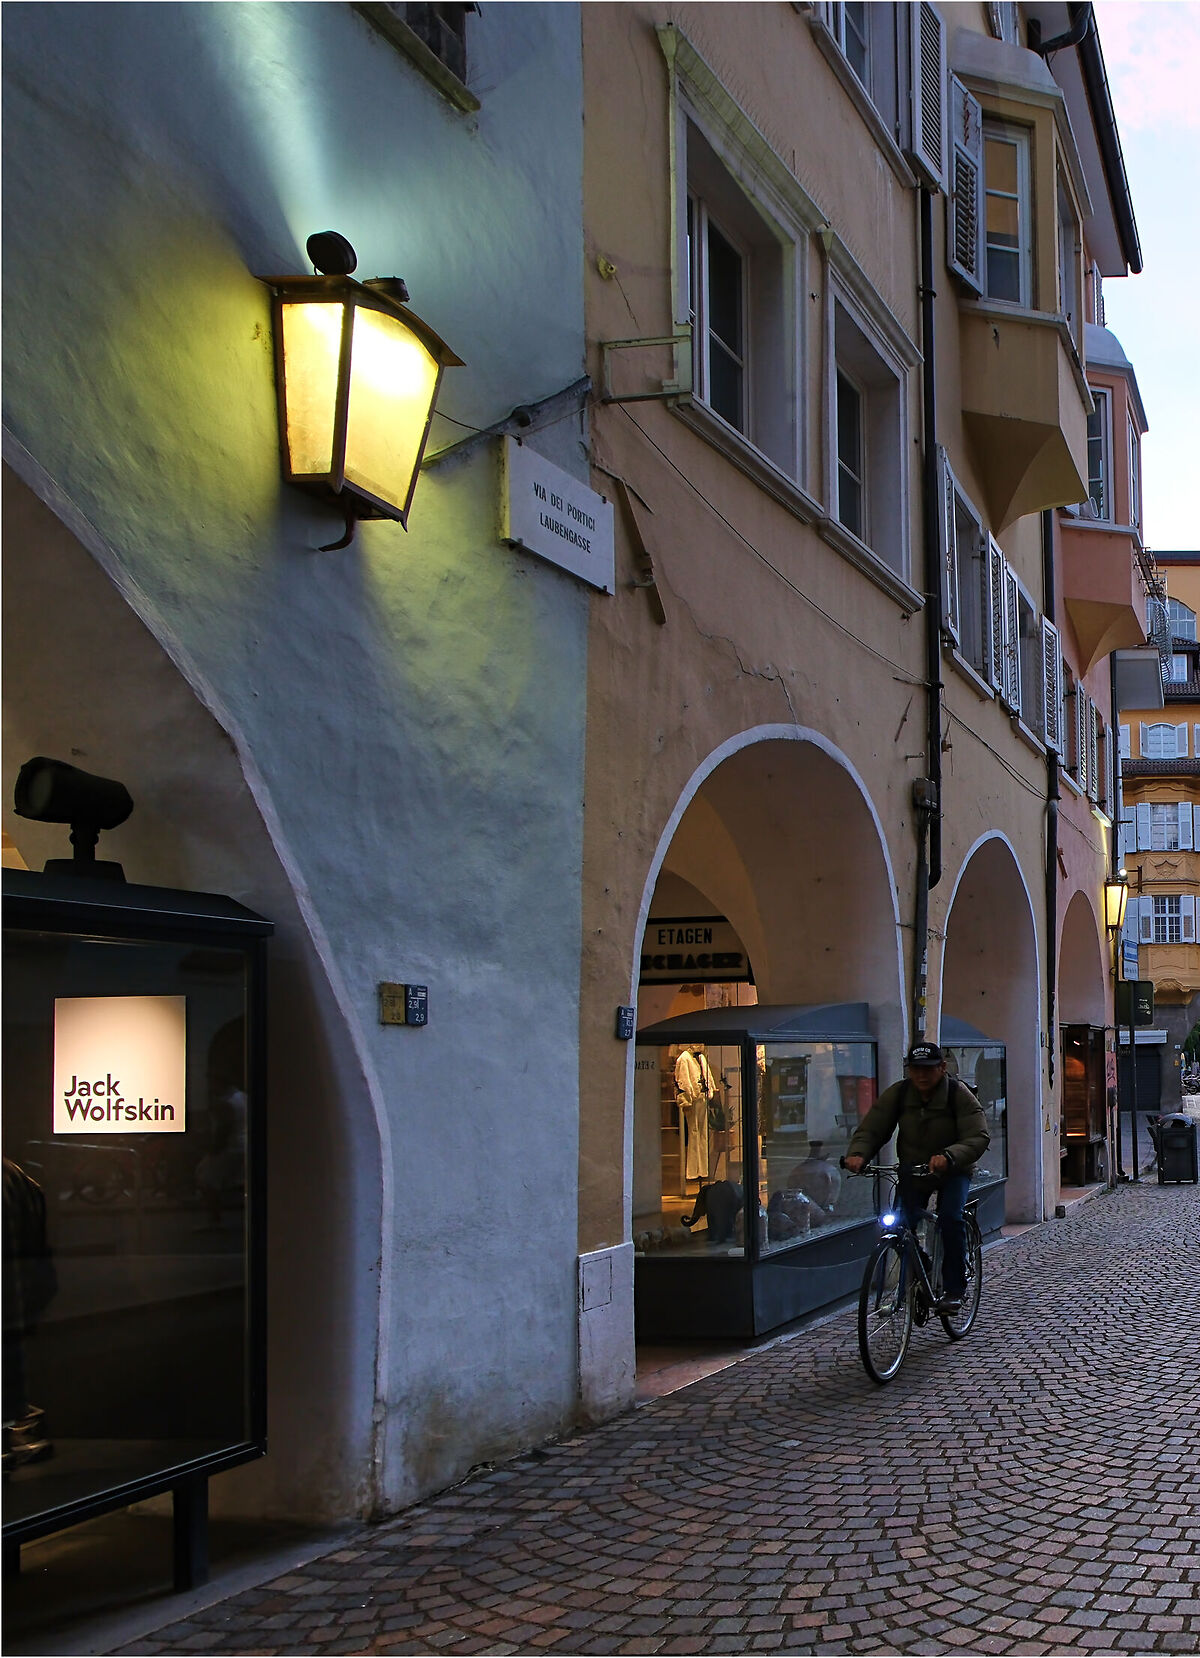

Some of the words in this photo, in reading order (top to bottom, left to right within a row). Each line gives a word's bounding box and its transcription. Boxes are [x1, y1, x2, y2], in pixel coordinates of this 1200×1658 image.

[533, 482, 547, 503] VIA
[550, 492, 563, 512] DEI
[567, 503, 596, 532] PORTICI
[540, 512, 592, 554] LAUBENGASSE
[658, 928, 713, 945] ETAGEN
[64, 1073, 121, 1097] Jack
[64, 1097, 175, 1121] Wolfskin
